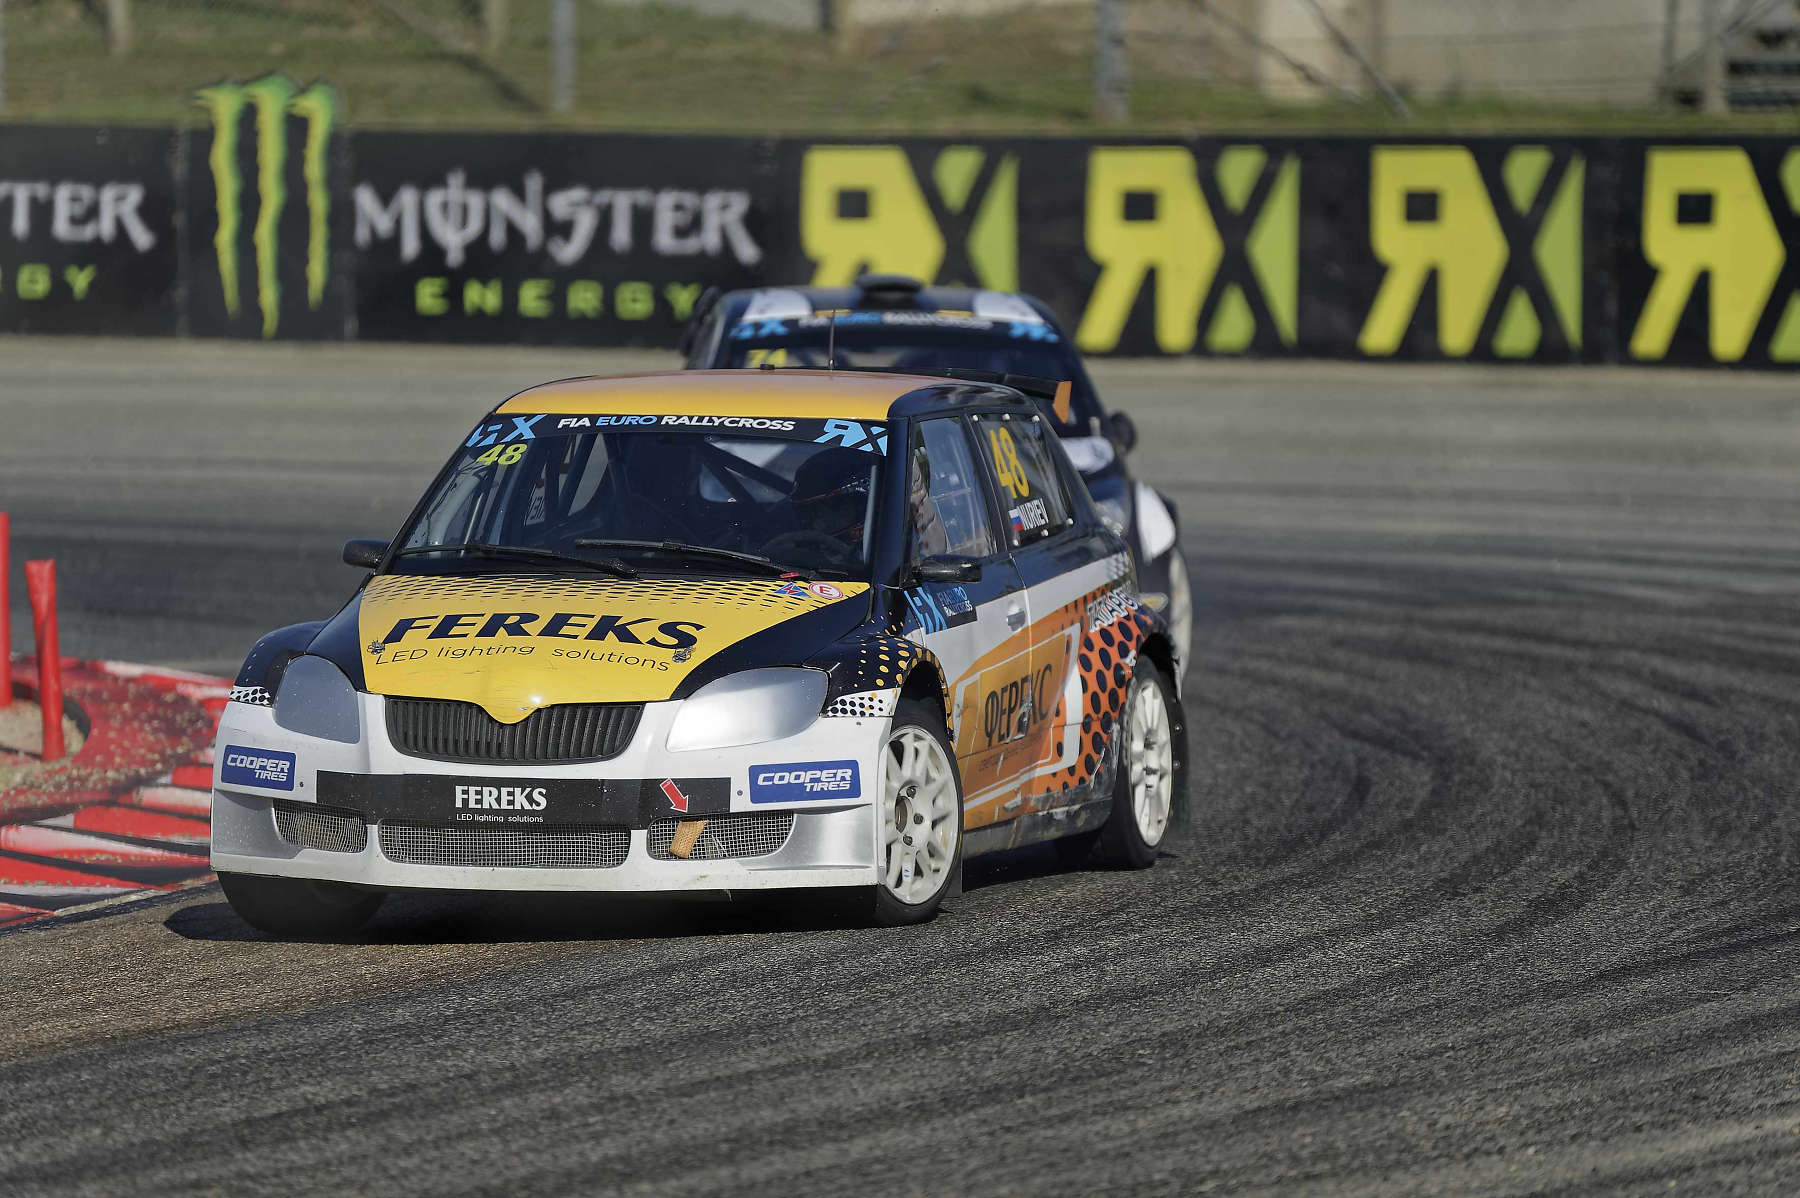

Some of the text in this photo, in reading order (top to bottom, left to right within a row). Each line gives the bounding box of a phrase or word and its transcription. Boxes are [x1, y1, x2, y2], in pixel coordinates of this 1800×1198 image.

[354, 168, 762, 266] MONSTER
[0, 264, 97, 299] GY
[415, 277, 701, 319] ENERGY
[557, 415, 797, 431] FIA EURO RALLYCROSS
[475, 443, 528, 467] 48
[989, 427, 1030, 499] 48
[383, 612, 706, 650] FEREKS
[375, 643, 670, 672] LED lighting solutions
[226, 753, 290, 773] COOPER
[254, 769, 288, 781] TIRES
[757, 768, 852, 785] COOPER
[804, 781, 851, 791] TIRES
[455, 785, 547, 810] FEREKS
[456, 813, 544, 823] LED lighting solutions
